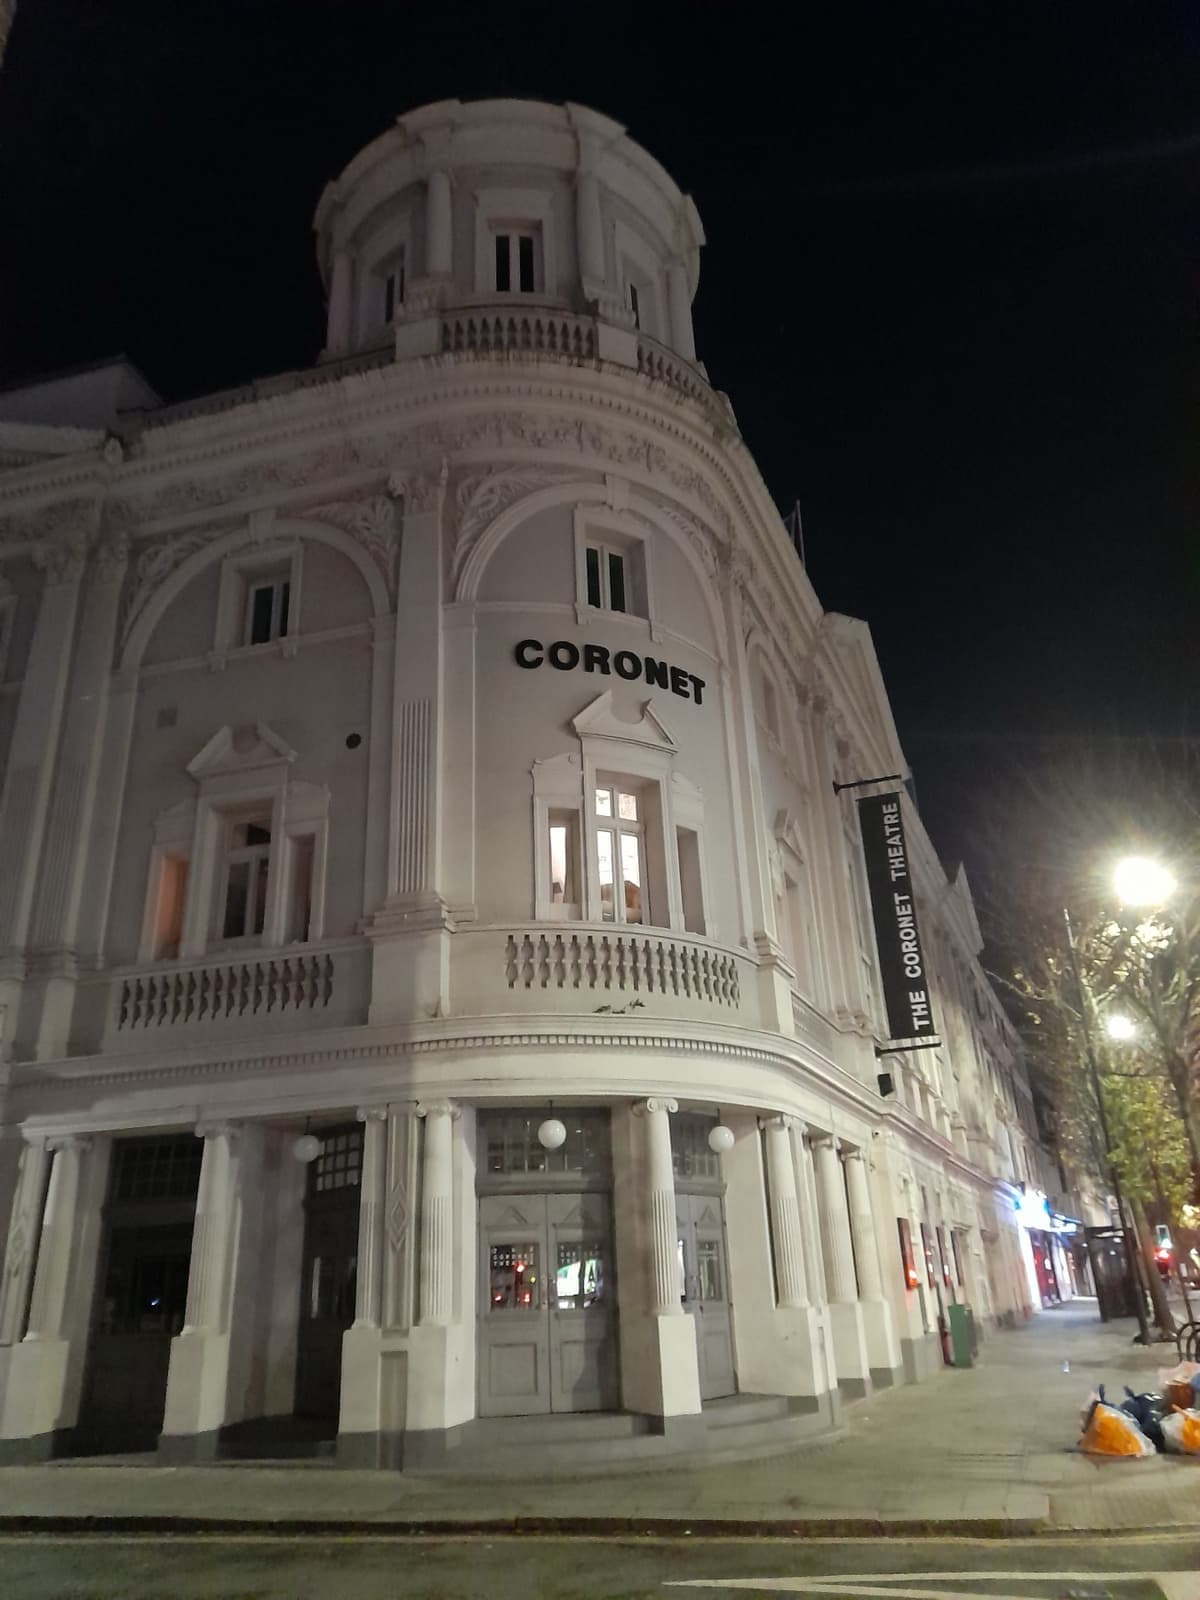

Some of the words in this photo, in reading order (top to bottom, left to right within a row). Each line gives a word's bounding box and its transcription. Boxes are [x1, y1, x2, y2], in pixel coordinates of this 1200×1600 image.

[515, 639, 706, 705] CORONET
[882, 803, 907, 882] THEATRE
[894, 892, 922, 978] CORONET
[909, 990, 930, 1031] THE
